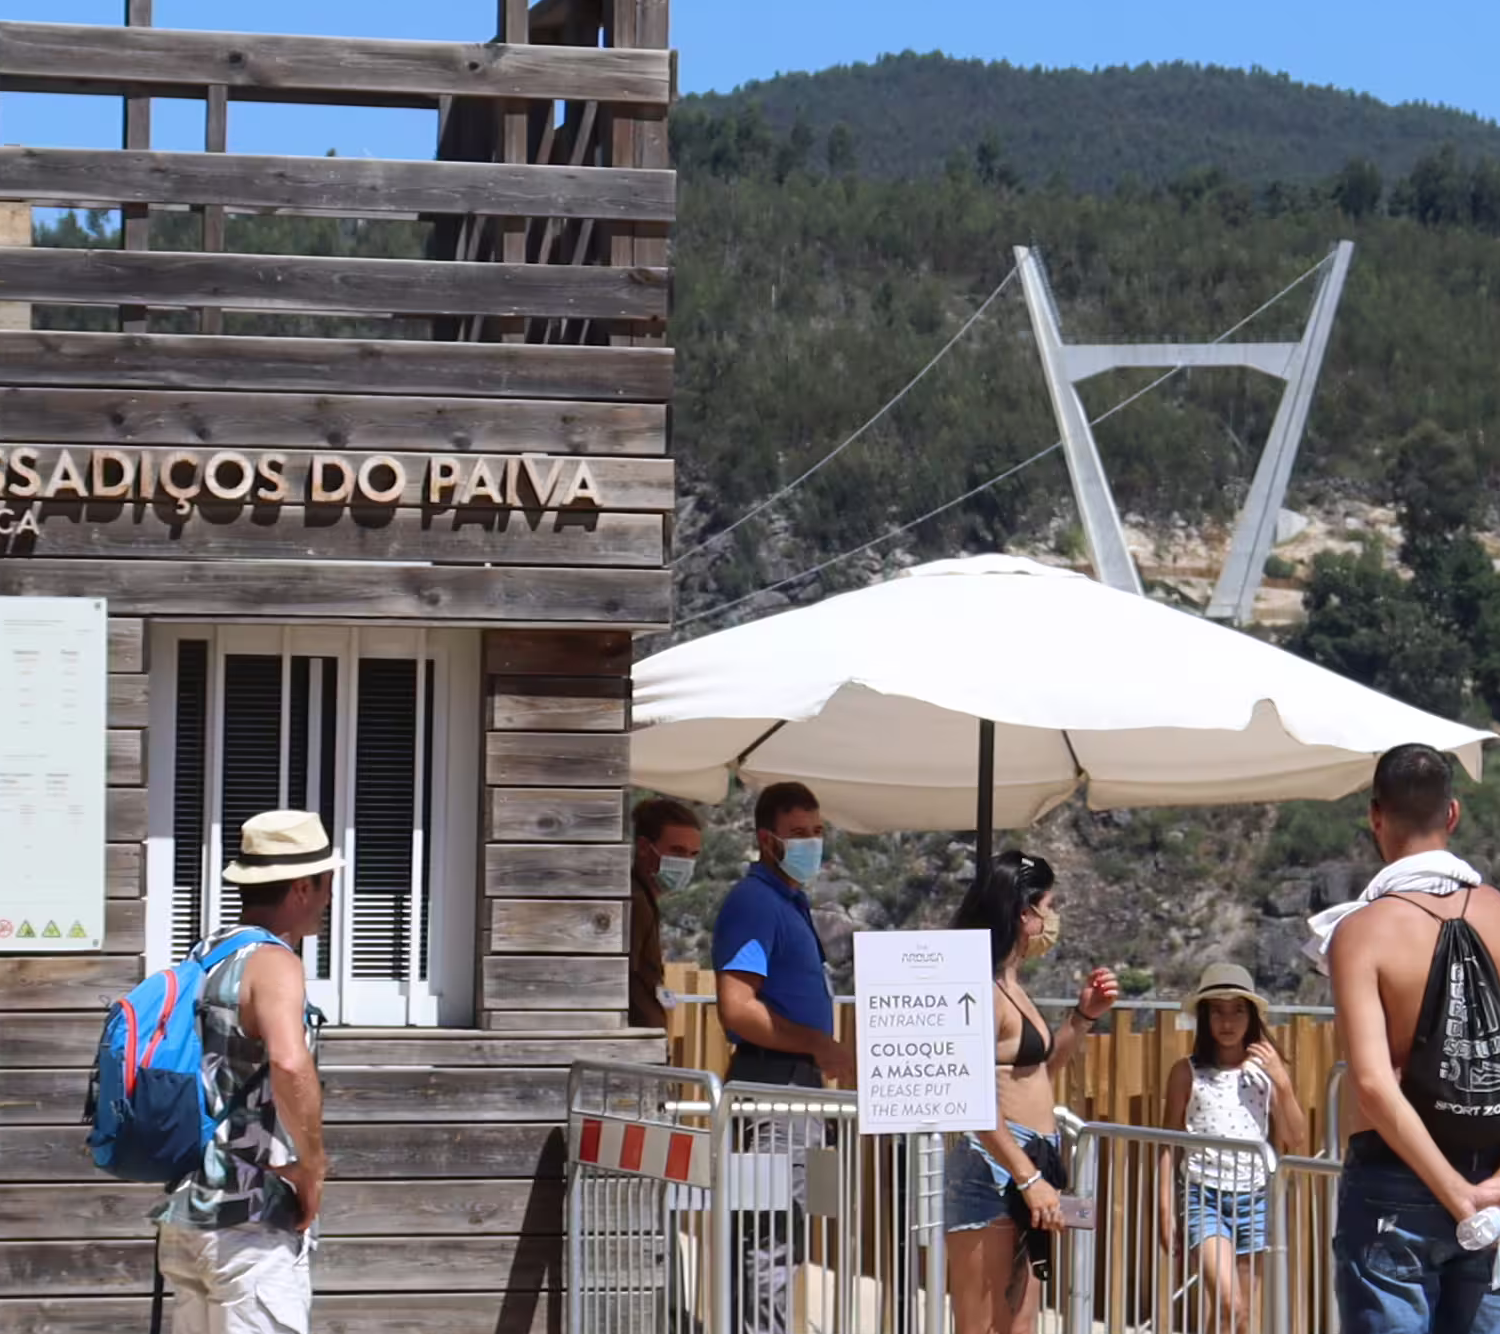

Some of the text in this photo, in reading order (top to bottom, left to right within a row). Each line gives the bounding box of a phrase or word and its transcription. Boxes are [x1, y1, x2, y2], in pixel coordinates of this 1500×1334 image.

[311, 455, 406, 503] DO
[429, 457, 602, 506] PAIVA
[869, 994, 948, 1009] ENTRADA
[869, 1013, 946, 1028] ENTRANCE
[870, 1042, 955, 1058] COLOQUE
[871, 1061, 970, 1079] A MÁSCARA
[870, 1083, 951, 1098] PLEASE PUT
[872, 1102, 968, 1117] THE MASK ON
[1434, 1099, 1480, 1117] SPORT
